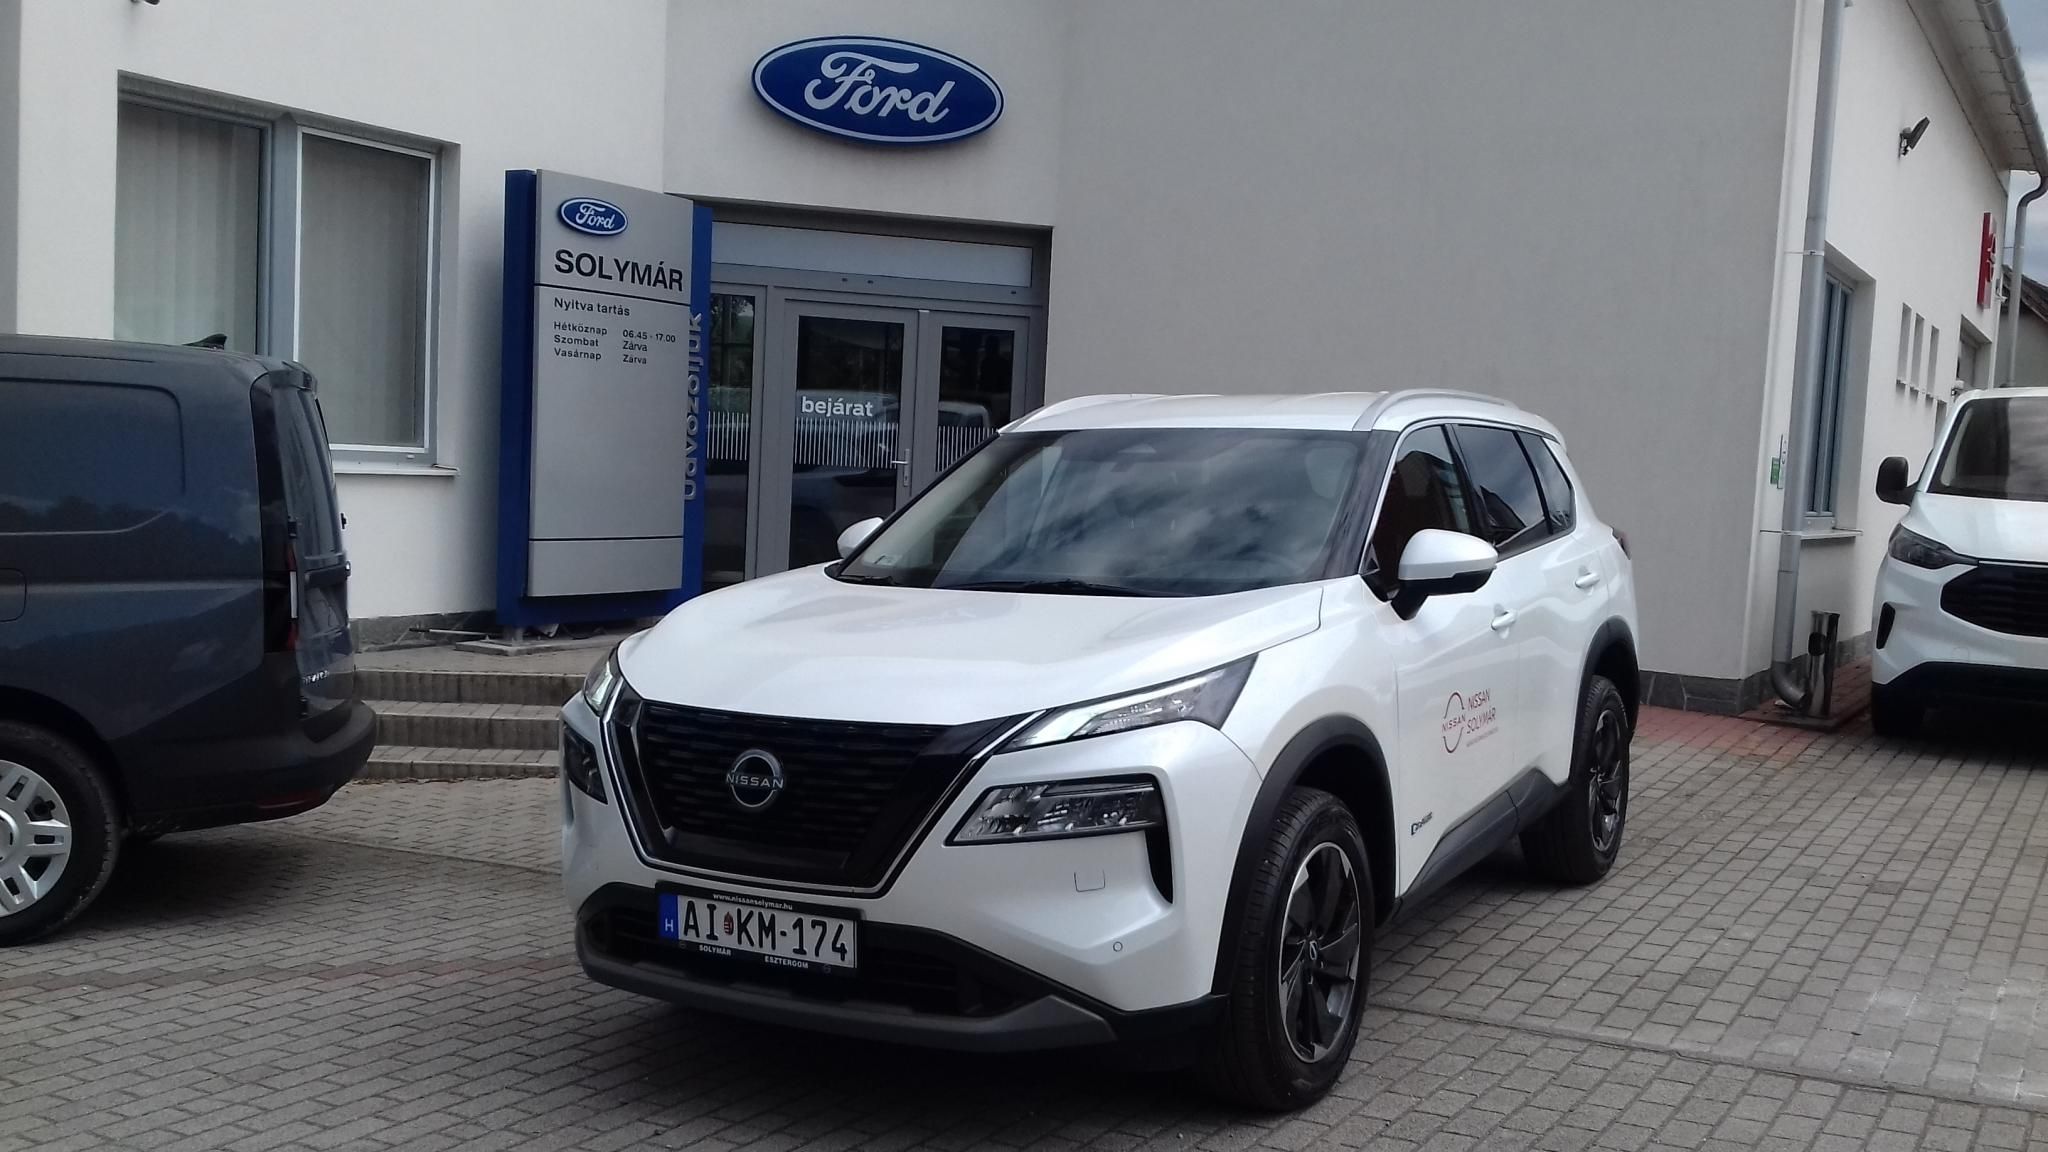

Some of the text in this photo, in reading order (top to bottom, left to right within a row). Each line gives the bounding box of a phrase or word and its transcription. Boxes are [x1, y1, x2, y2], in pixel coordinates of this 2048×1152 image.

[804, 51, 955, 123] Ford
[575, 203, 616, 230] Ford
[554, 249, 684, 292] SOLYMÁR
[554, 297, 631, 317] Nyitva tartás
[554, 321, 608, 336] Hétköznap
[622, 329, 648, 340] 06.45
[655, 333, 676, 343] 17.00
[554, 334, 648, 352] Szombat Zárva
[554, 347, 647, 365] Vasárnap Zárva
[801, 395, 874, 418] bejárat
[1467, 689, 1491, 711] NISSAN
[1442, 714, 1465, 731] NISSAN
[726, 773, 784, 790] NISSAN
[712, 893, 793, 911] www.nissansolymar.hu
[664, 918, 675, 933] H
[683, 900, 848, 963] AI KM-174
[764, 955, 809, 970] ESZTERGOM
